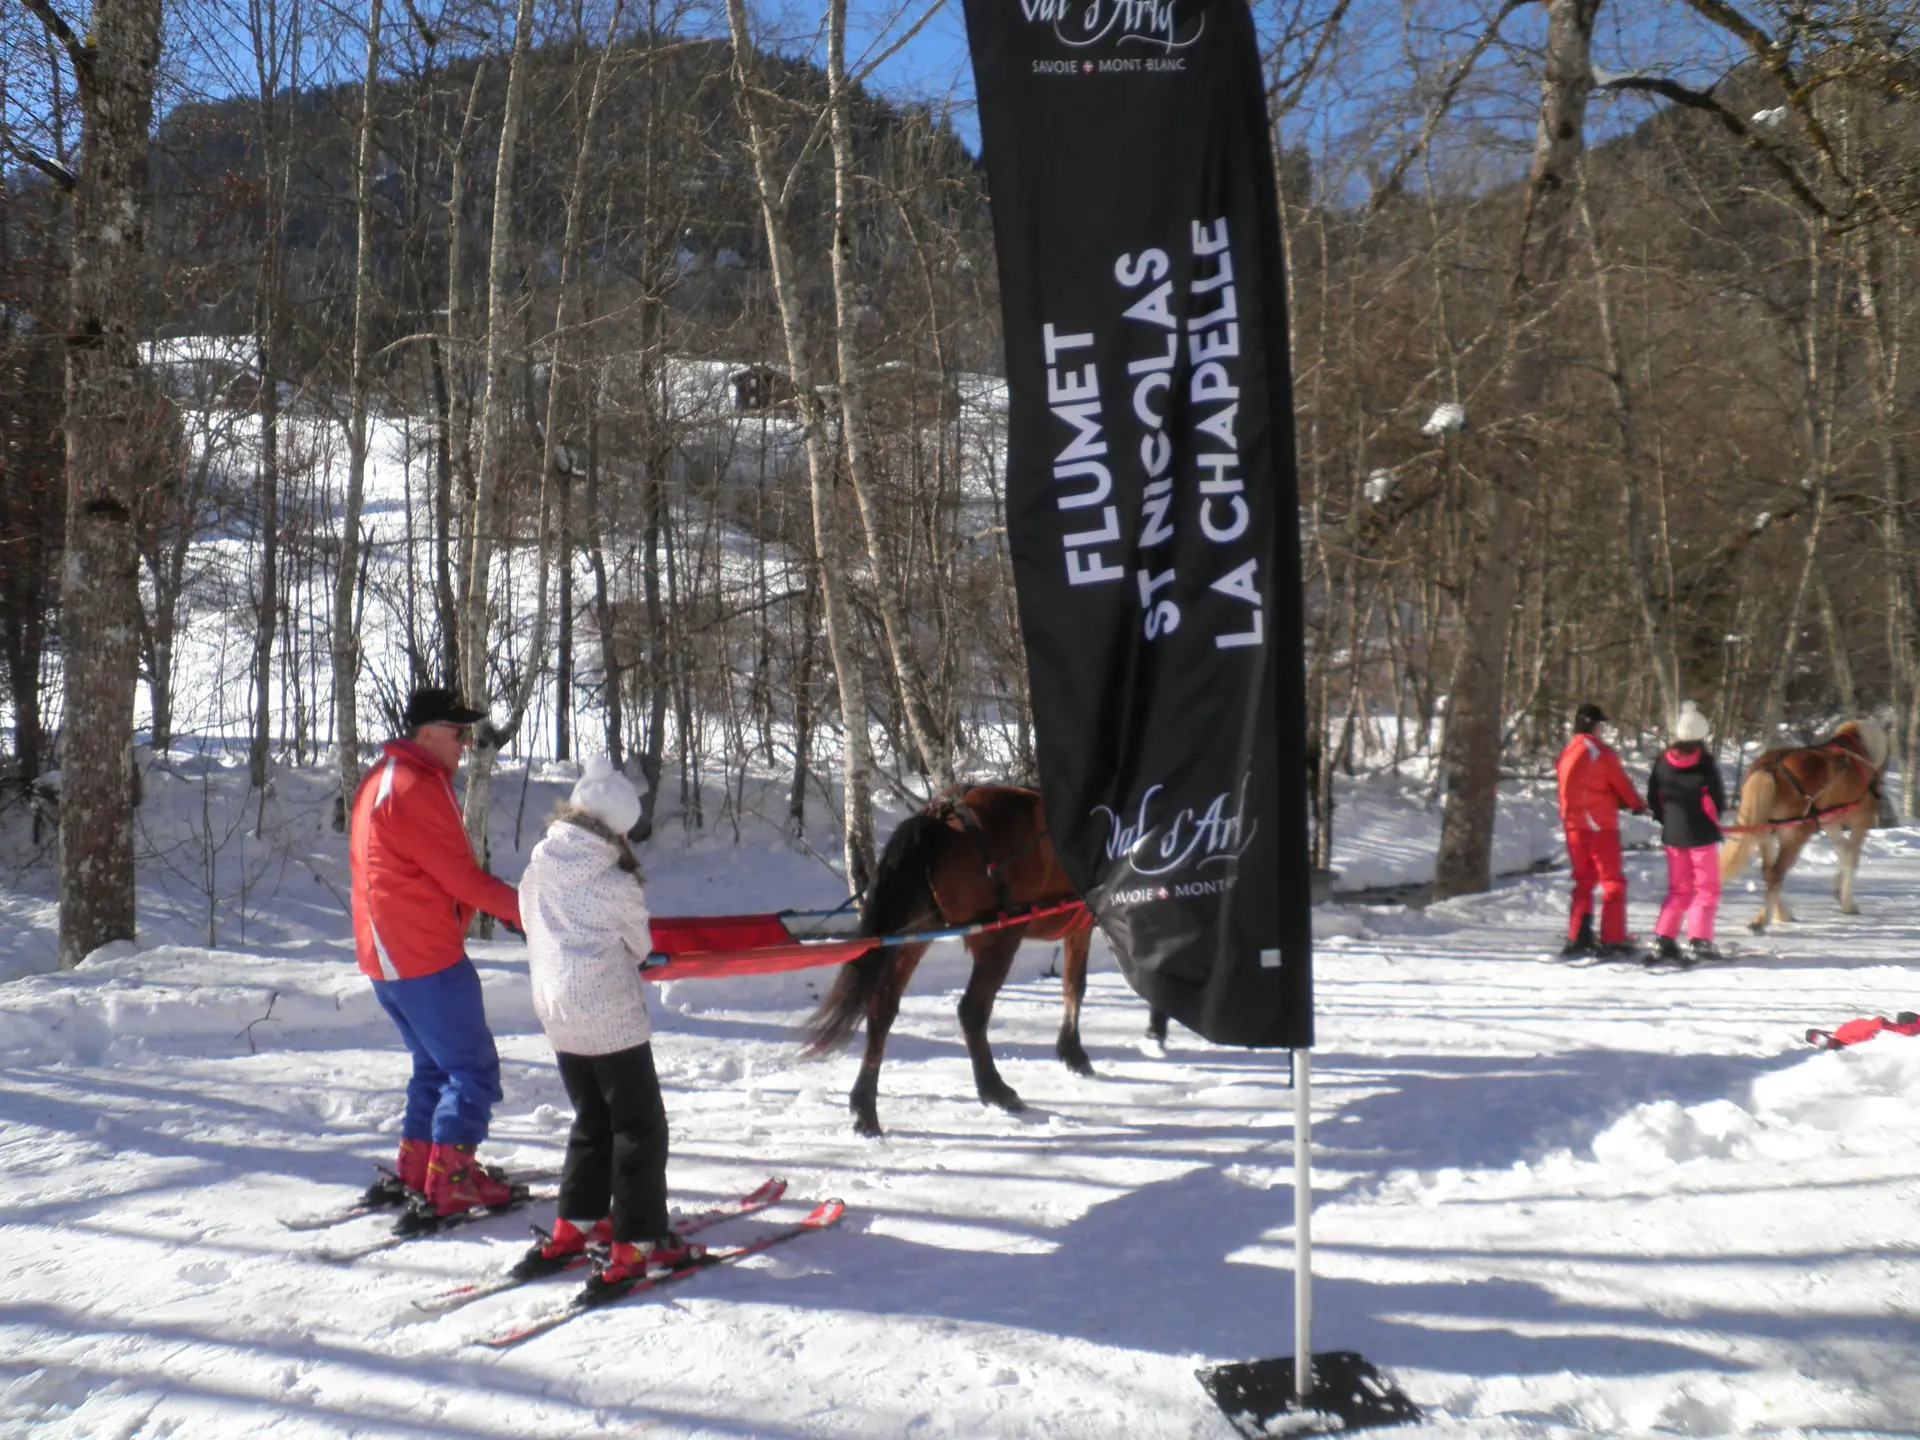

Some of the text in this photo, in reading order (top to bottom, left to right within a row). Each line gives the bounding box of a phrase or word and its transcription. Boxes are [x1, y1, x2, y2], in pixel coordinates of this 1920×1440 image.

[1031, 57, 1187, 74] SAVOIE MONT BLANC
[1043, 322, 1125, 586] FLUMET
[1114, 247, 1182, 641] ST NICOLAS
[1186, 215, 1264, 650] LA CHAPELLE
[1089, 783, 1164, 860] Val
[1109, 887, 1154, 906] SAVOIE
[1174, 878, 1226, 897] MONT
